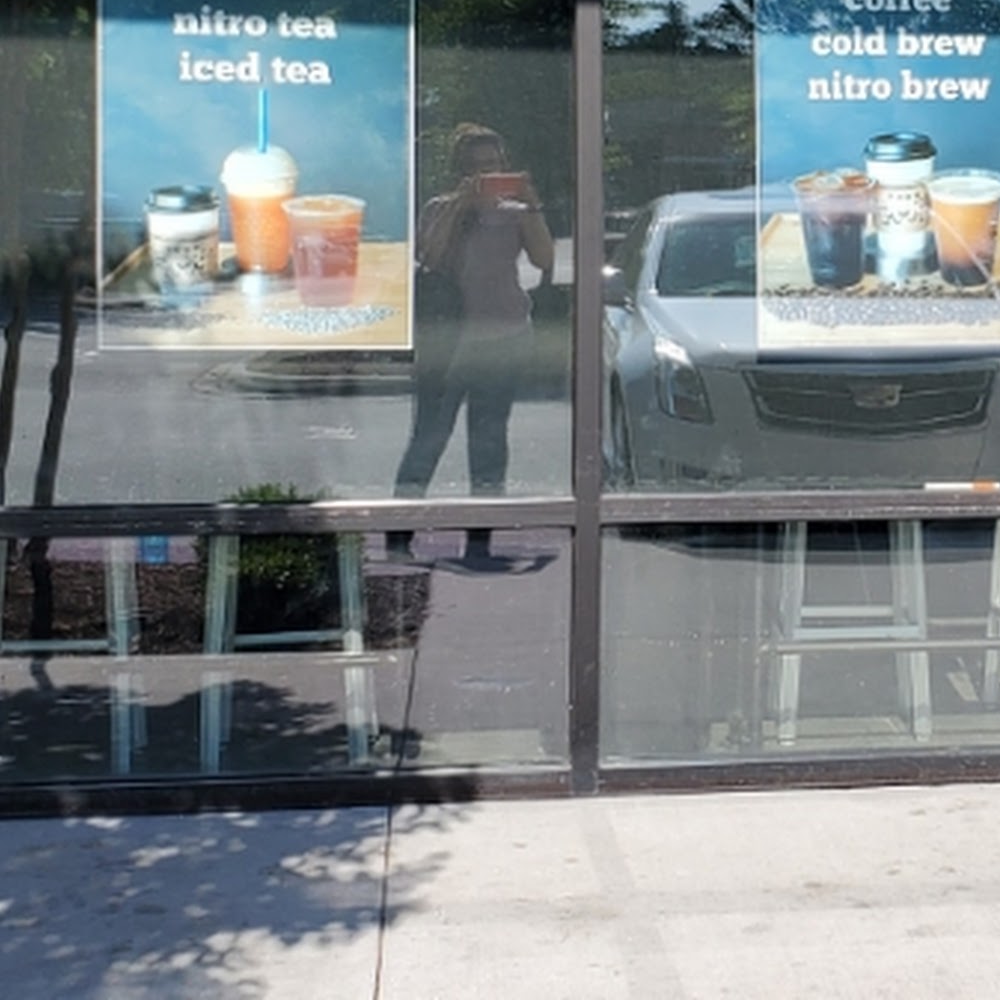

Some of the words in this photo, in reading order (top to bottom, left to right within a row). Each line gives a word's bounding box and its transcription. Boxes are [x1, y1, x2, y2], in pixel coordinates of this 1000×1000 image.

[173, 5, 268, 38] nitro
[277, 9, 338, 40] tea
[810, 26, 888, 57] cold
[896, 26, 986, 57] brew
[179, 50, 261, 83] iced
[271, 56, 332, 85] tea
[807, 70, 893, 101] nitro
[900, 69, 991, 101] brew
